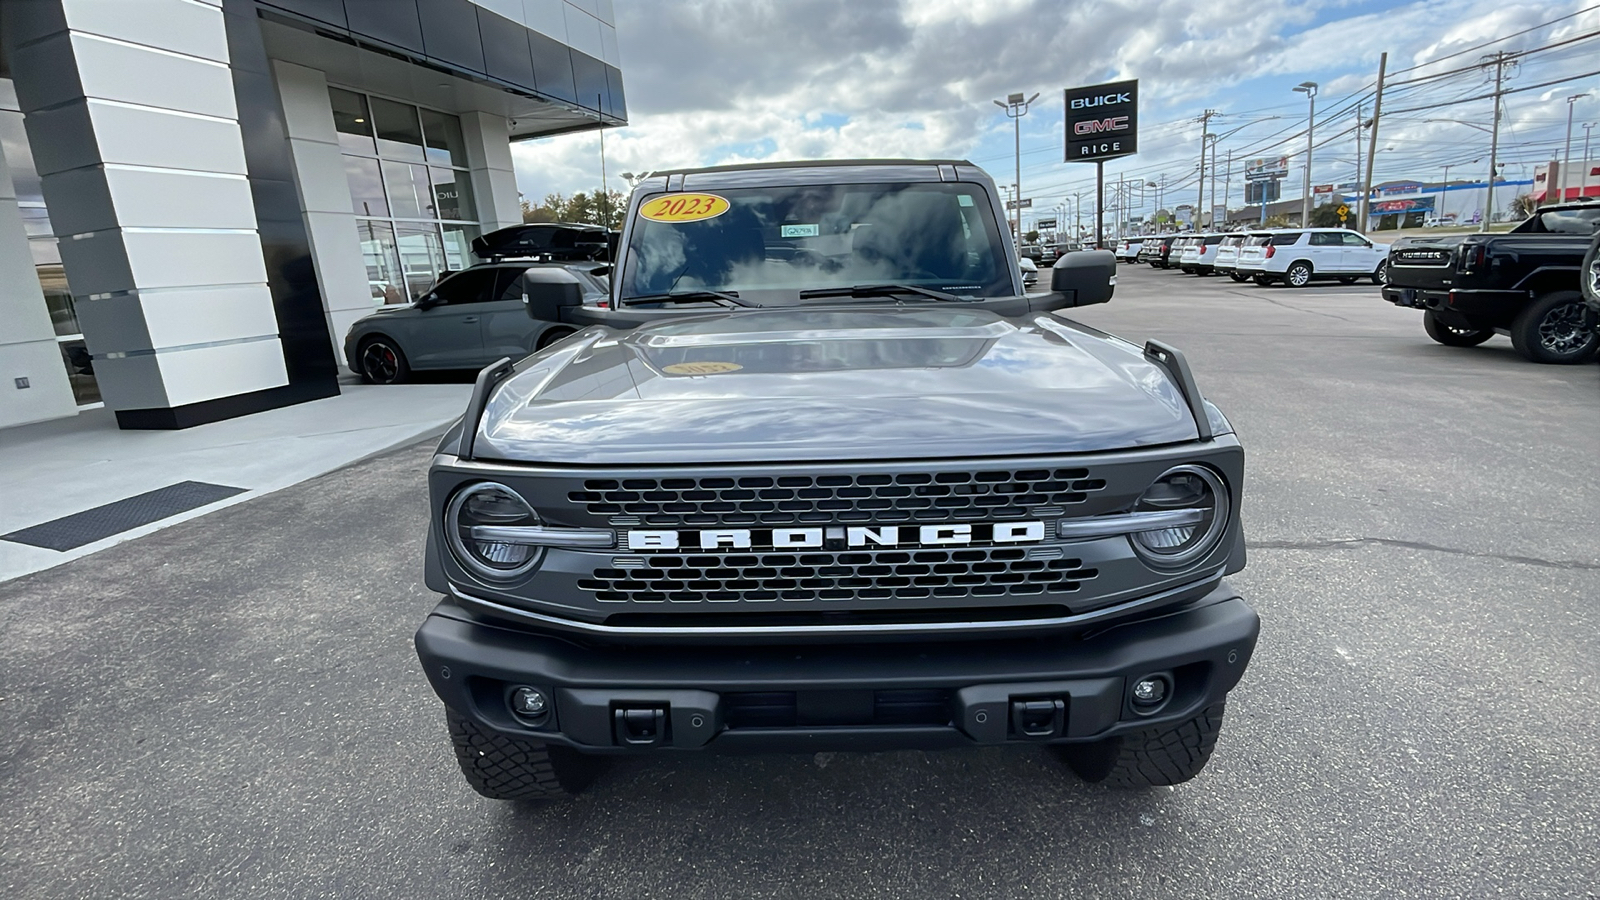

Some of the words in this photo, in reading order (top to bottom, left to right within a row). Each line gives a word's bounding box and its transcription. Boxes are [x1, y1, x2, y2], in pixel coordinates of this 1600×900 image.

[1071, 92, 1131, 109] BUICK
[1074, 116, 1128, 135] GMC
[1081, 142, 1120, 154] RICE
[653, 198, 716, 216] 2023
[628, 520, 1046, 550] BRONCO
